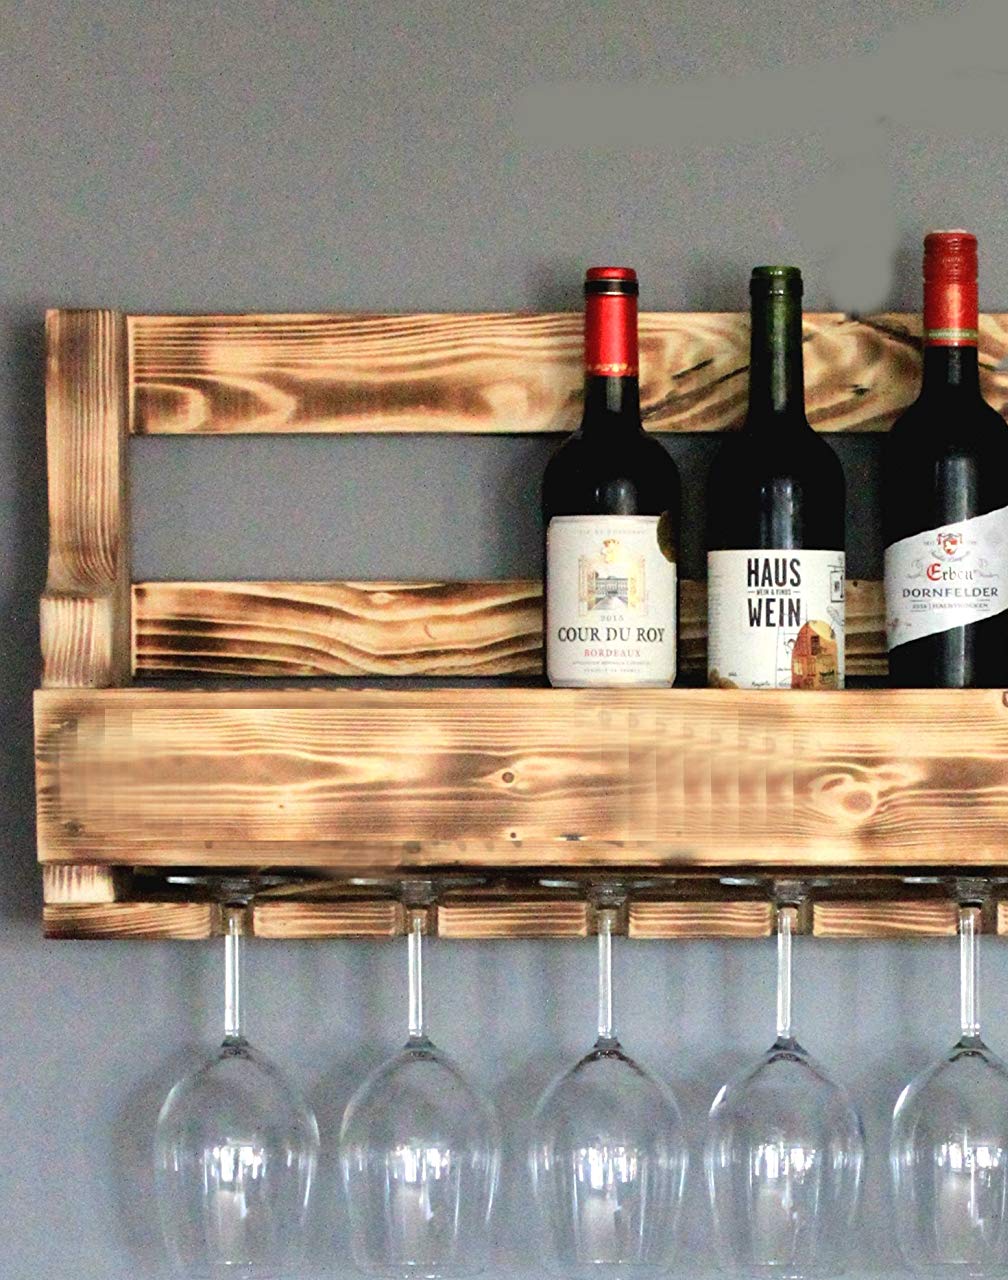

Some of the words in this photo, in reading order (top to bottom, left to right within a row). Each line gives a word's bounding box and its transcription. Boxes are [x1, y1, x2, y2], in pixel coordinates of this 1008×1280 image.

[747, 558, 801, 587] HAUS
[926, 562, 974, 581] Erben
[902, 587, 998, 598] DORNFELDER
[747, 598, 801, 627] WEIN
[558, 627, 600, 642] COUR
[606, 627, 631, 642] DU
[637, 627, 665, 642] ROY
[584, 648, 641, 658] BORDEAUX
